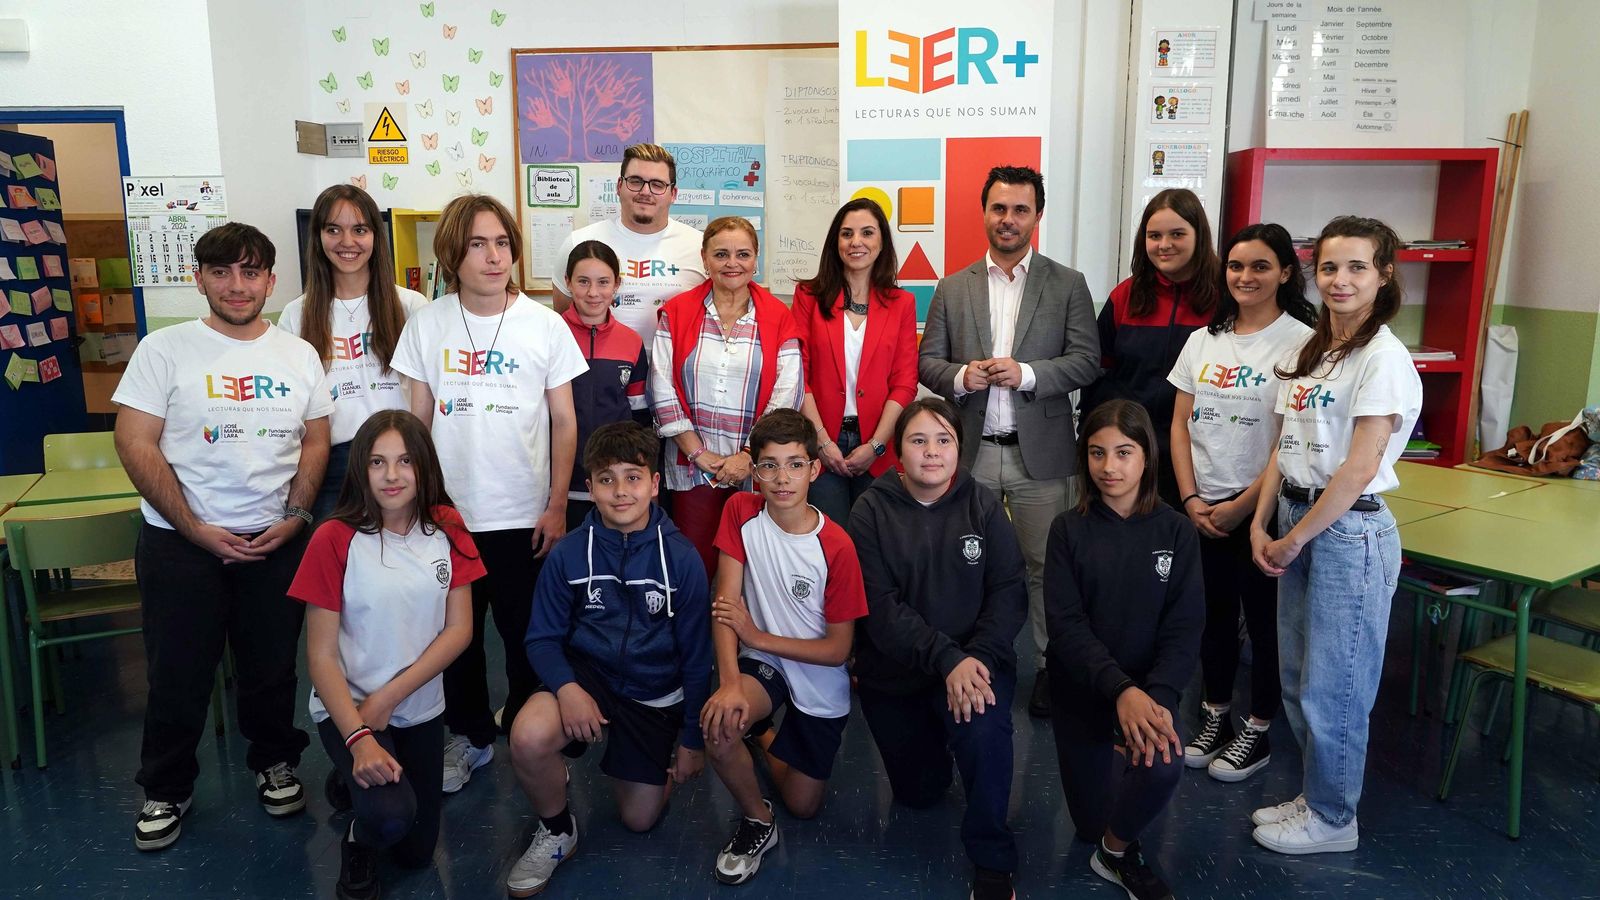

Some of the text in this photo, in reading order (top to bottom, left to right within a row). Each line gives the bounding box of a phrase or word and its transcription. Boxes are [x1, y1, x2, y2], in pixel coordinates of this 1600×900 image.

[785, 87, 837, 97] DIPTONGOS
[856, 106, 1036, 118] LECTURAS QUE NOS SUMAN
[666, 146, 756, 164] HOSPITAL
[136, 234, 194, 242] 1 2 3 4 5
[137, 244, 140, 252] 8
[150, 244, 154, 252] 9
[163, 244, 169, 252] 10
[177, 244, 182, 252] 11
[138, 275, 159, 283] 29 30
